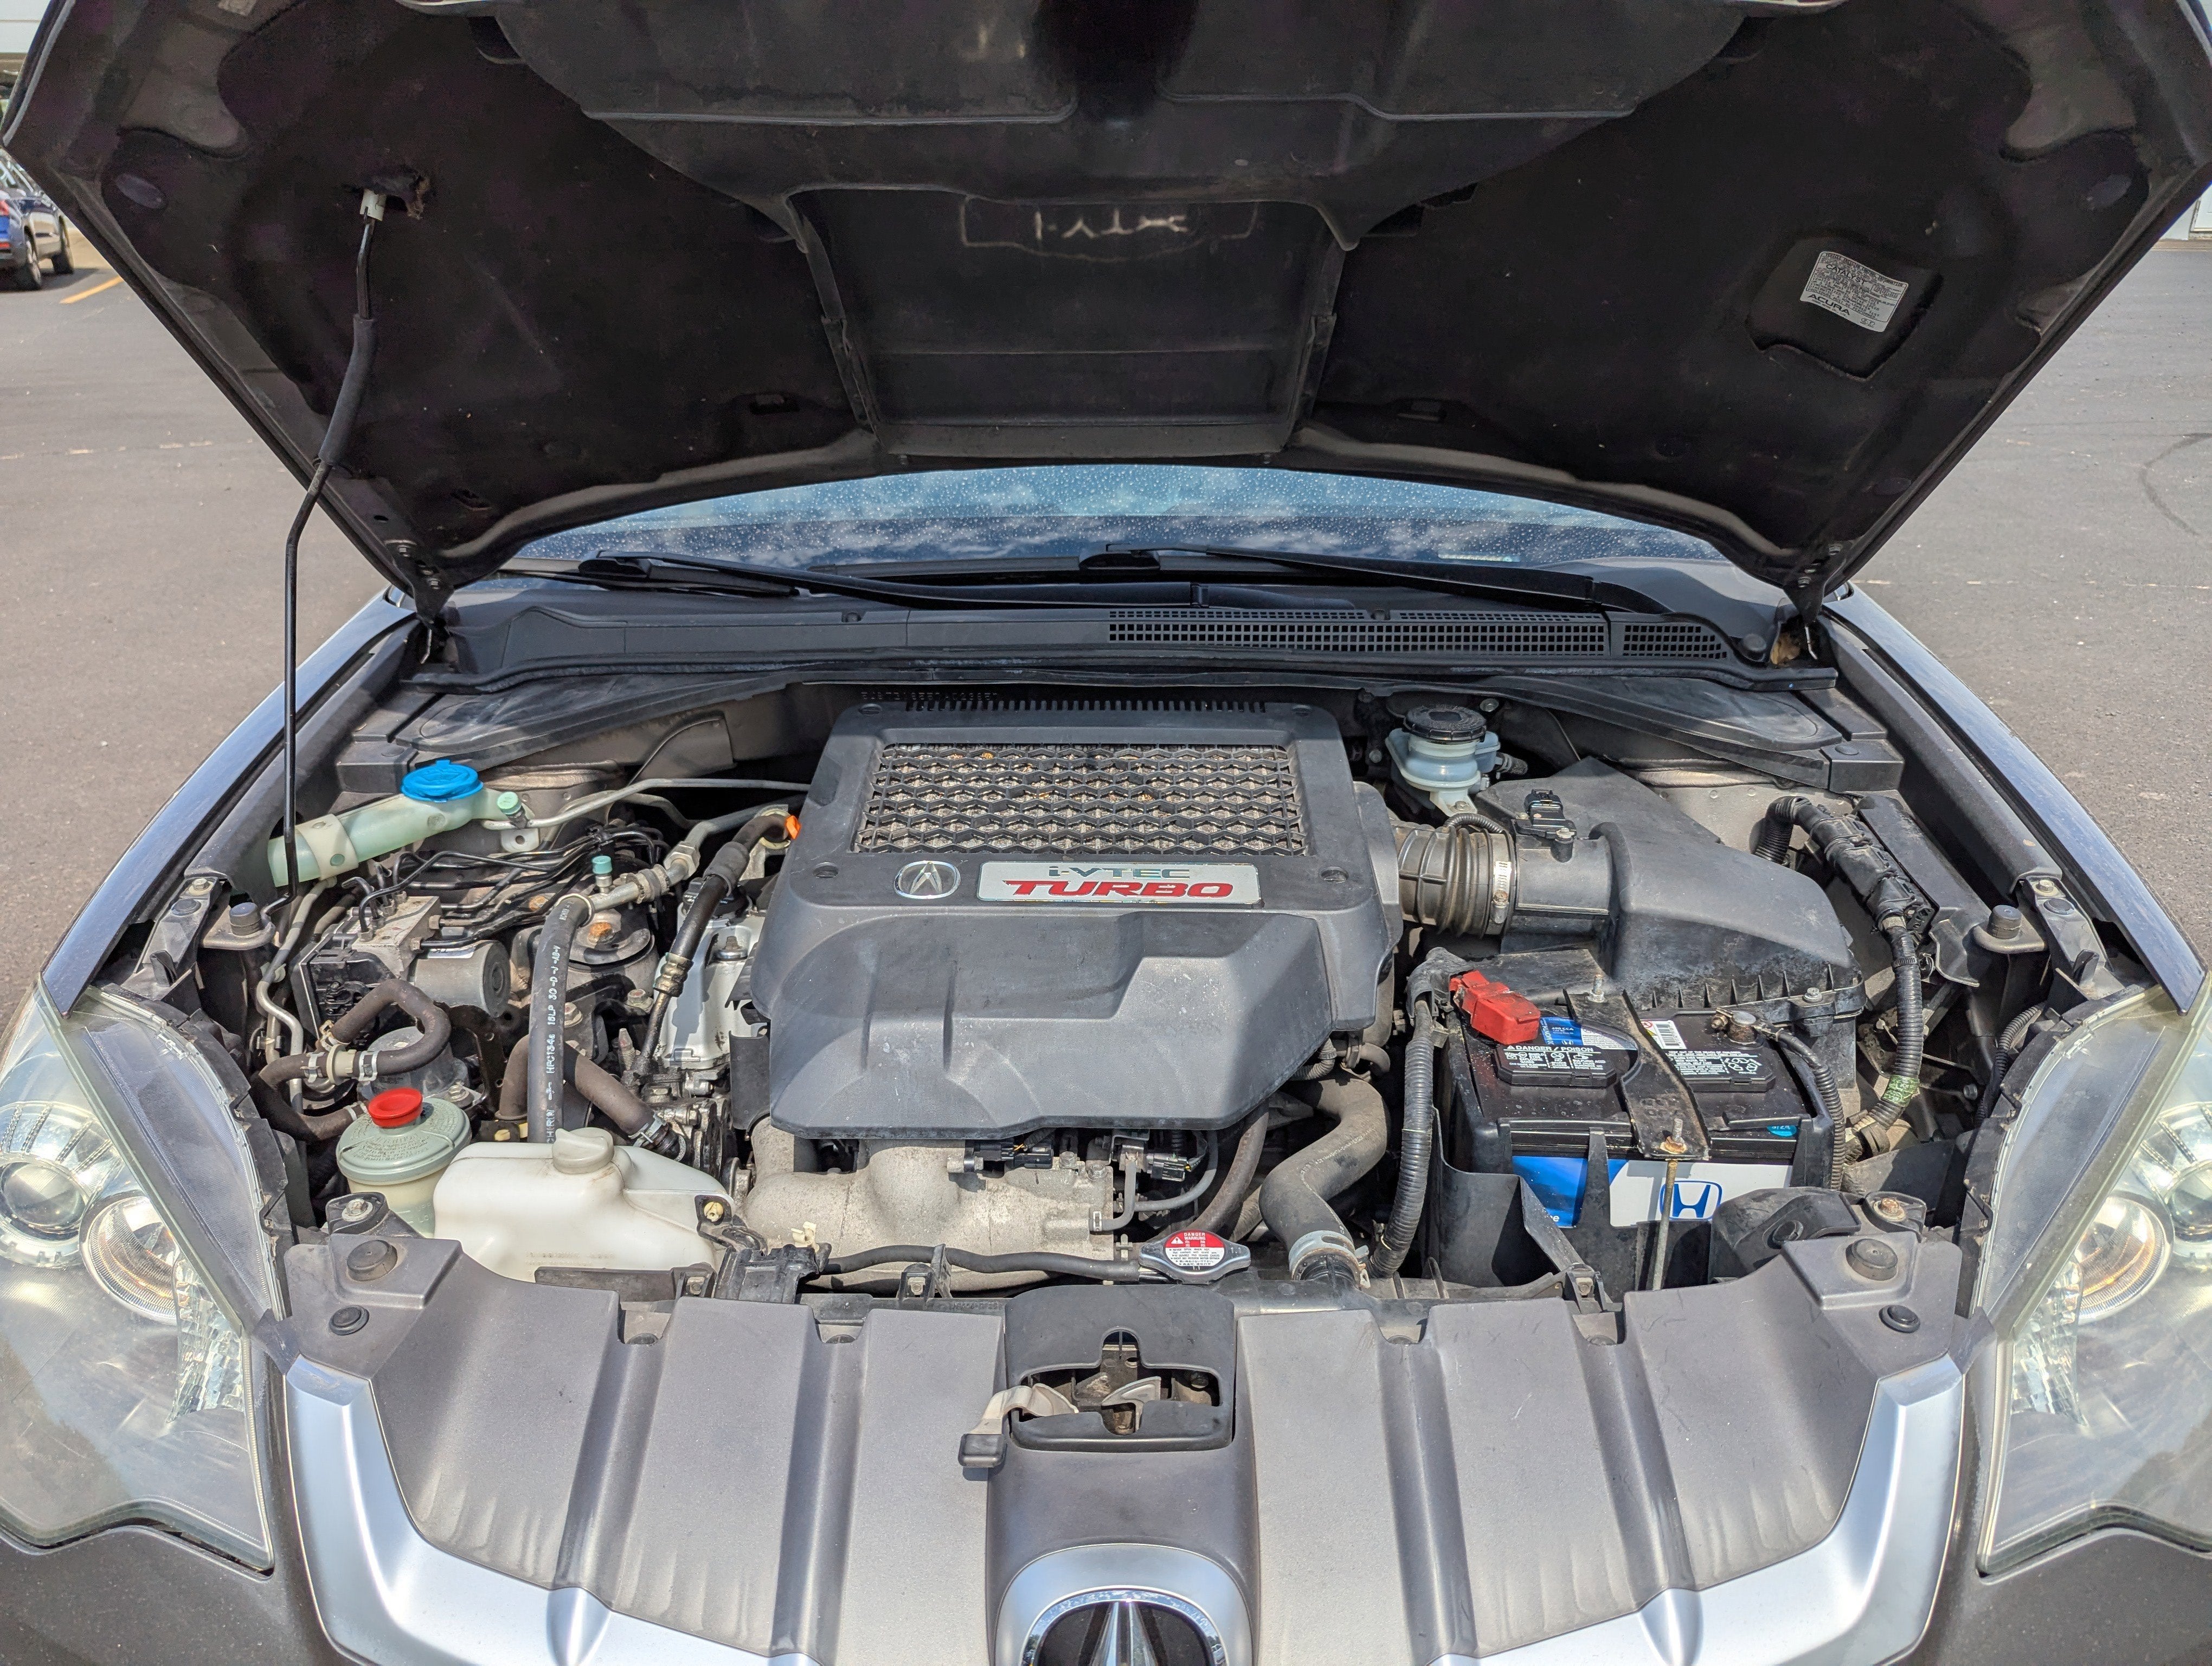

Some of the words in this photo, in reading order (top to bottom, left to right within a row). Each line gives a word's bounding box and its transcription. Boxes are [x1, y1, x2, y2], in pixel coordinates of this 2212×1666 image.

[1826, 264, 1867, 285] CATALYST
[1808, 294, 1850, 315] ACURA
[1049, 866, 1190, 879] i-VTEC
[1003, 880, 1233, 898] TURBO
